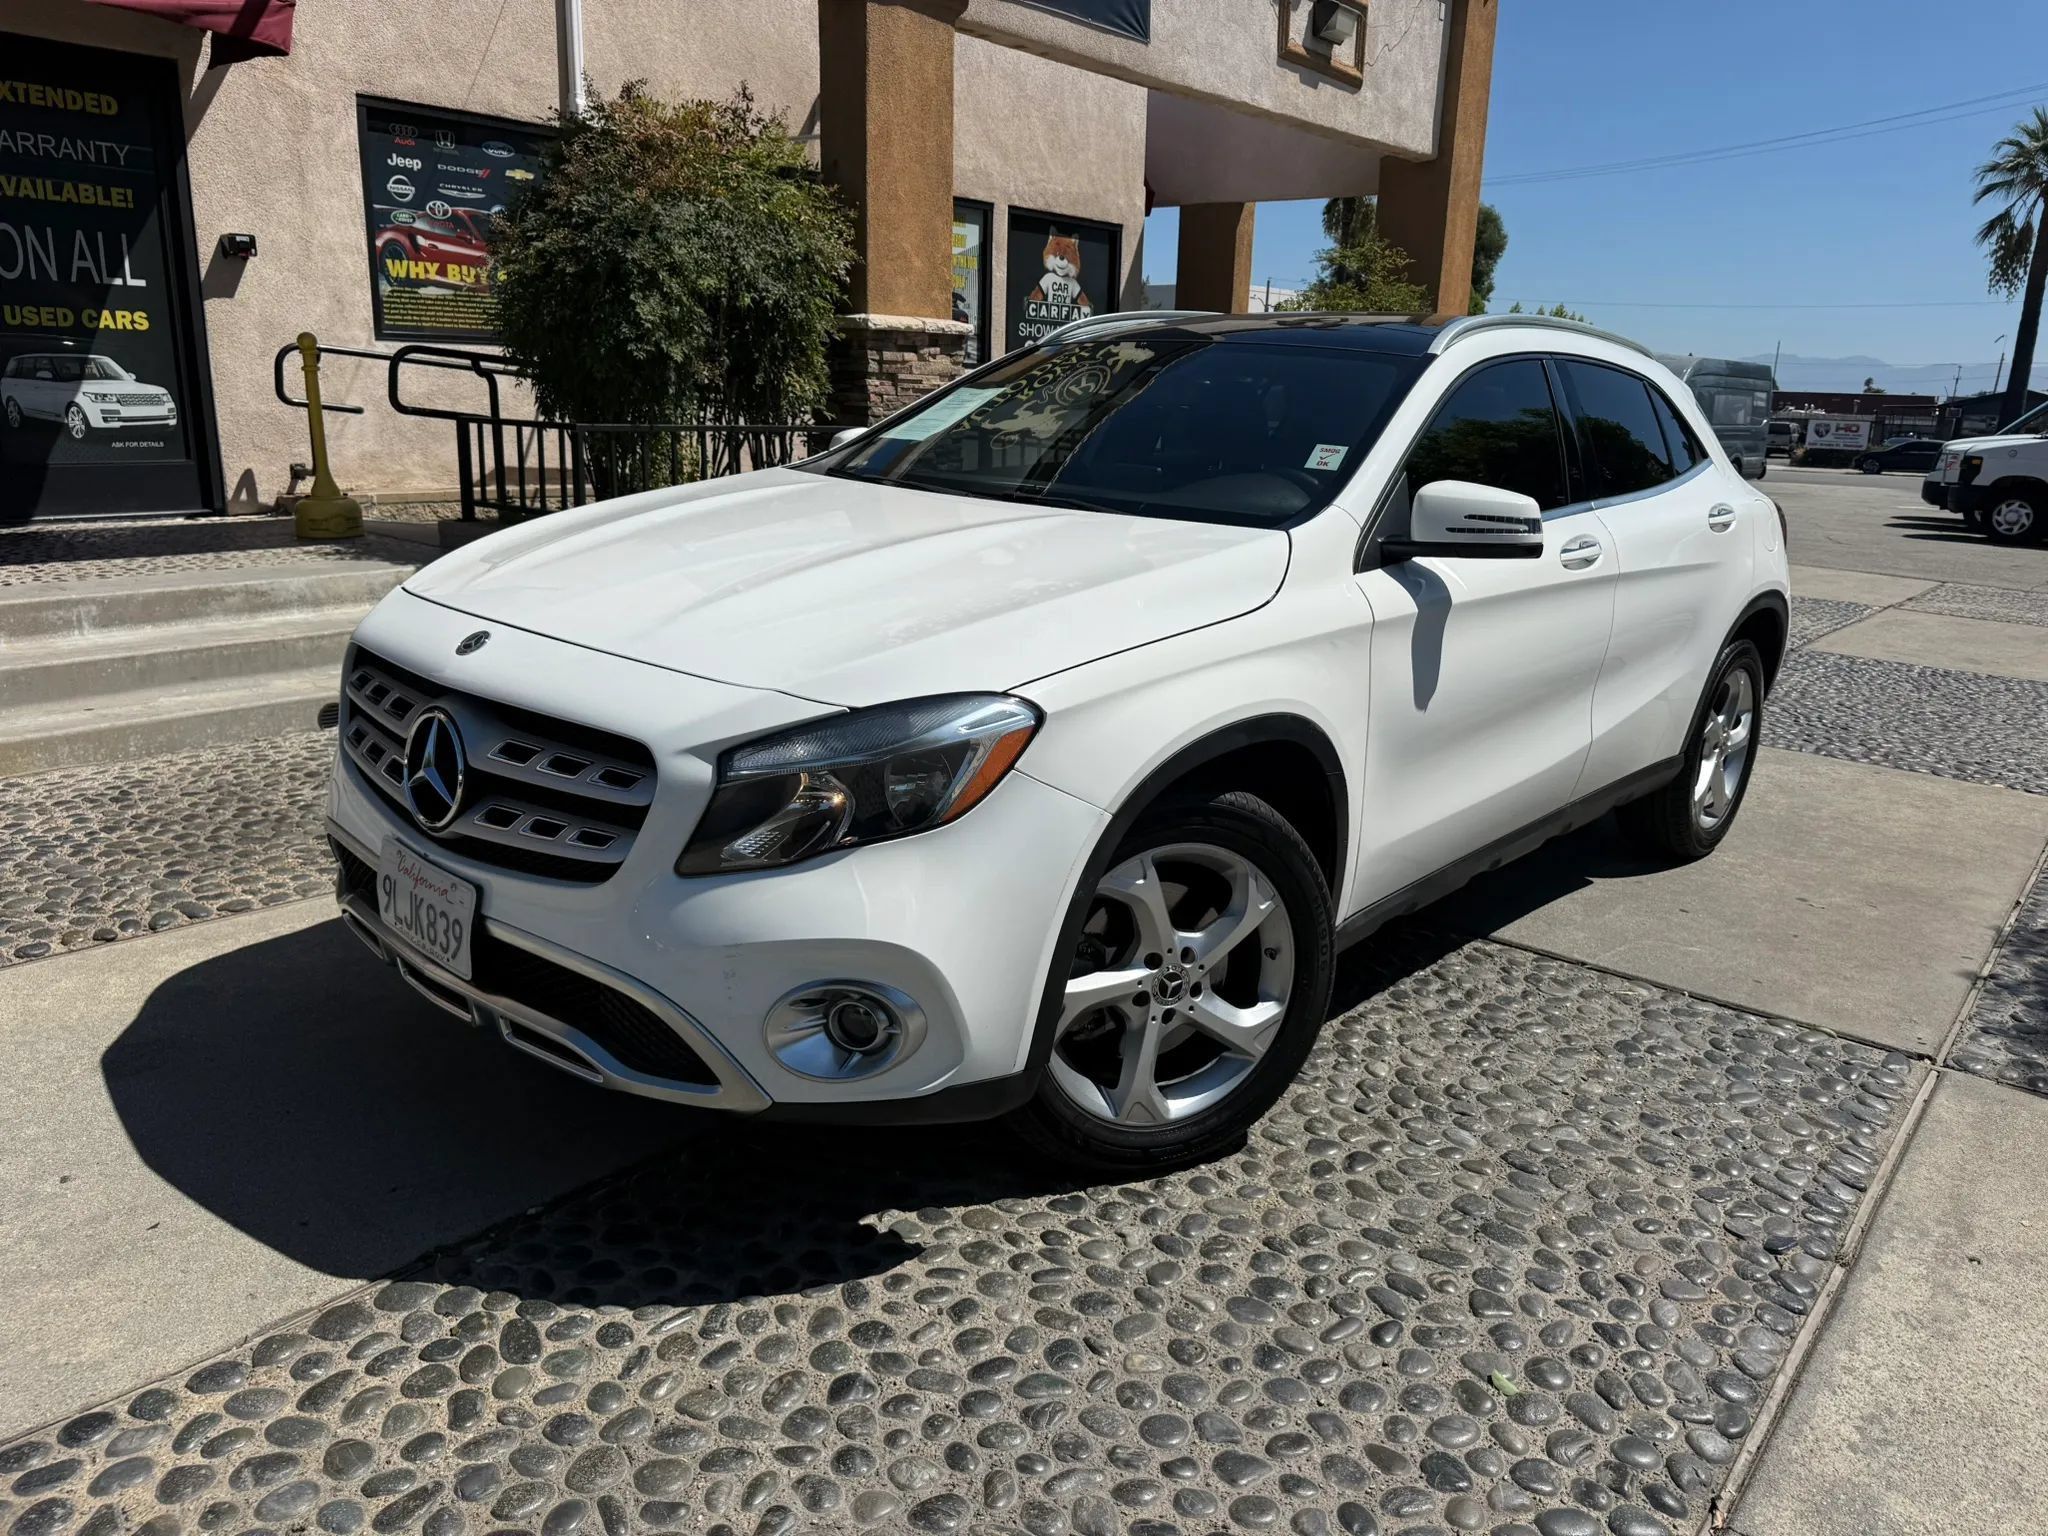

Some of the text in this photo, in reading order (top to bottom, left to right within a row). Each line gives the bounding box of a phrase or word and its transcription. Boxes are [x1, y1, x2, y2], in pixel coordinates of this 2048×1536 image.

[0, 130, 130, 166] ARRANTY
[394, 136, 416, 147] Audi
[387, 153, 422, 171] Jeep
[437, 164, 483, 175] DODGE
[0, 175, 134, 209] VAILABLE!
[389, 185, 413, 193] NISSAN
[439, 183, 483, 192] CHRYSLER
[0, 222, 146, 287] ON ALL
[386, 259, 440, 280] WHY
[1052, 282, 1069, 294] CAR
[1052, 294, 1068, 304] FOX
[3, 305, 150, 331] USED CARS
[395, 849, 455, 905] California
[383, 874, 463, 961] 9LJK839
